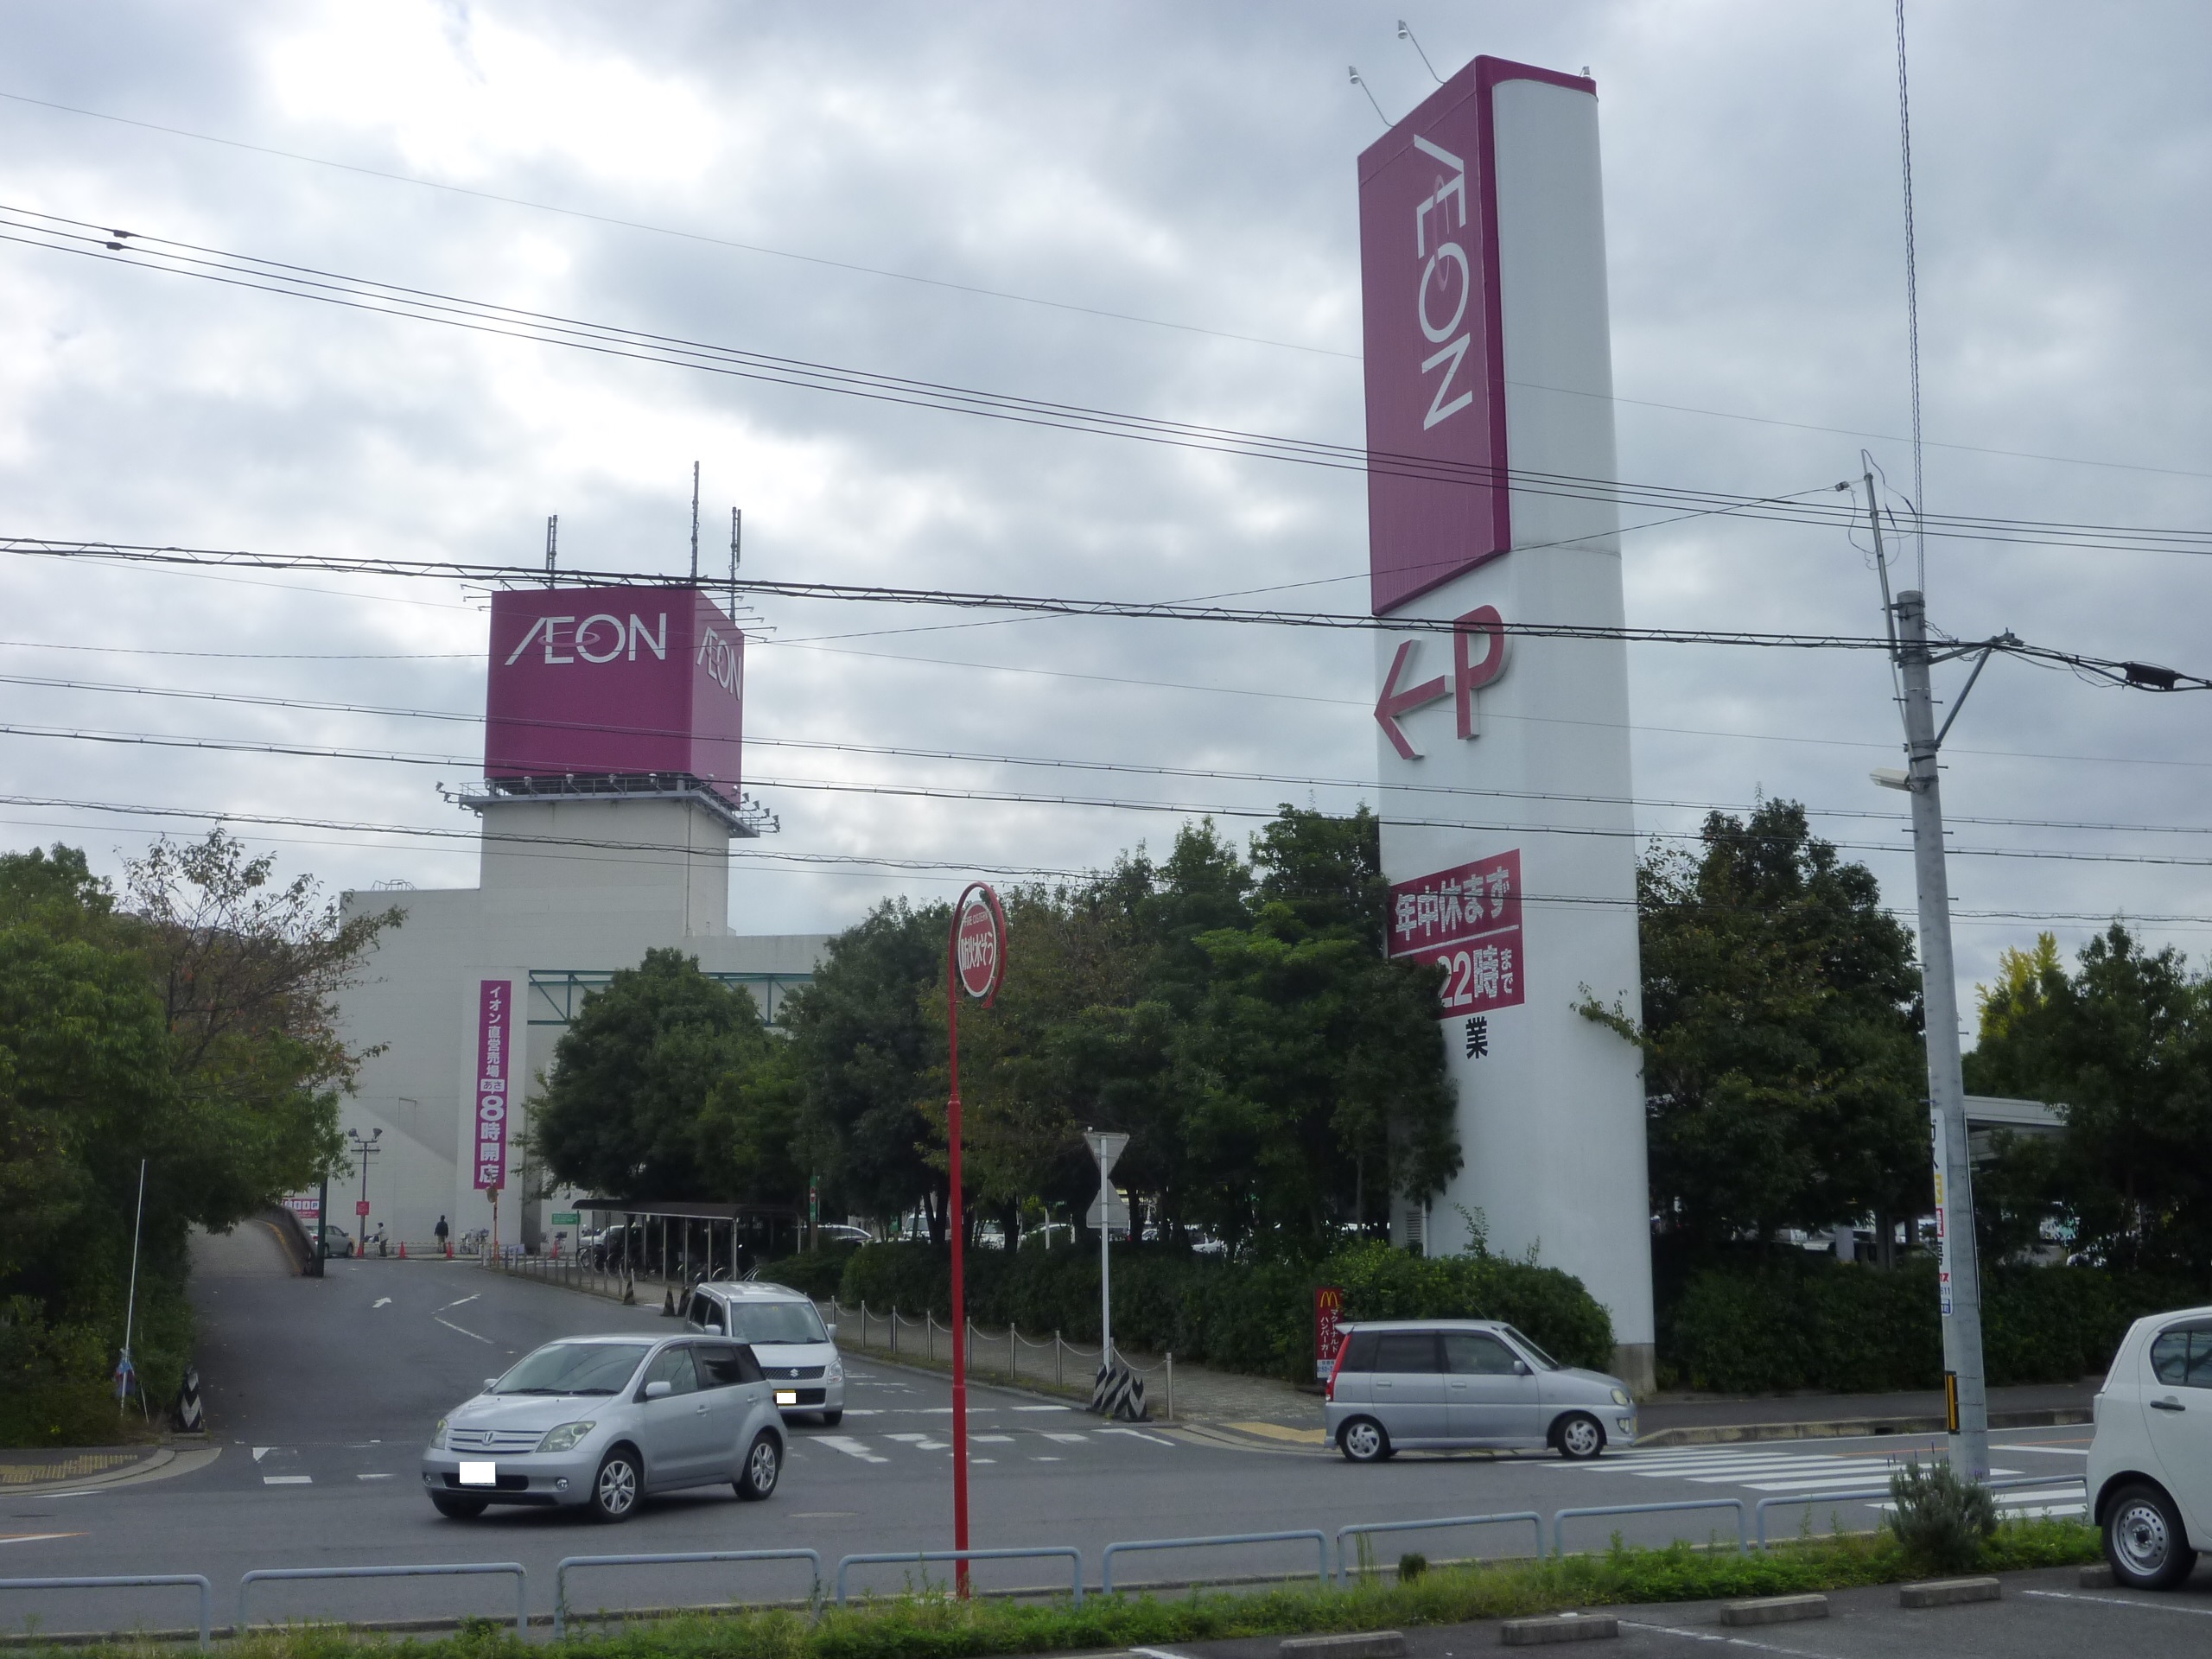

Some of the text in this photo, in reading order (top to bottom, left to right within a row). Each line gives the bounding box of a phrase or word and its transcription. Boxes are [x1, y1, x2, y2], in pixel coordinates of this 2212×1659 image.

[1453, 605, 1505, 740] P
[1395, 866, 1510, 942] 年中休まず
[961, 931, 993, 970] 防火水そう
[1465, 1016, 1488, 1059] 業
[1320, 1316, 1329, 1358] ハンバーガー
